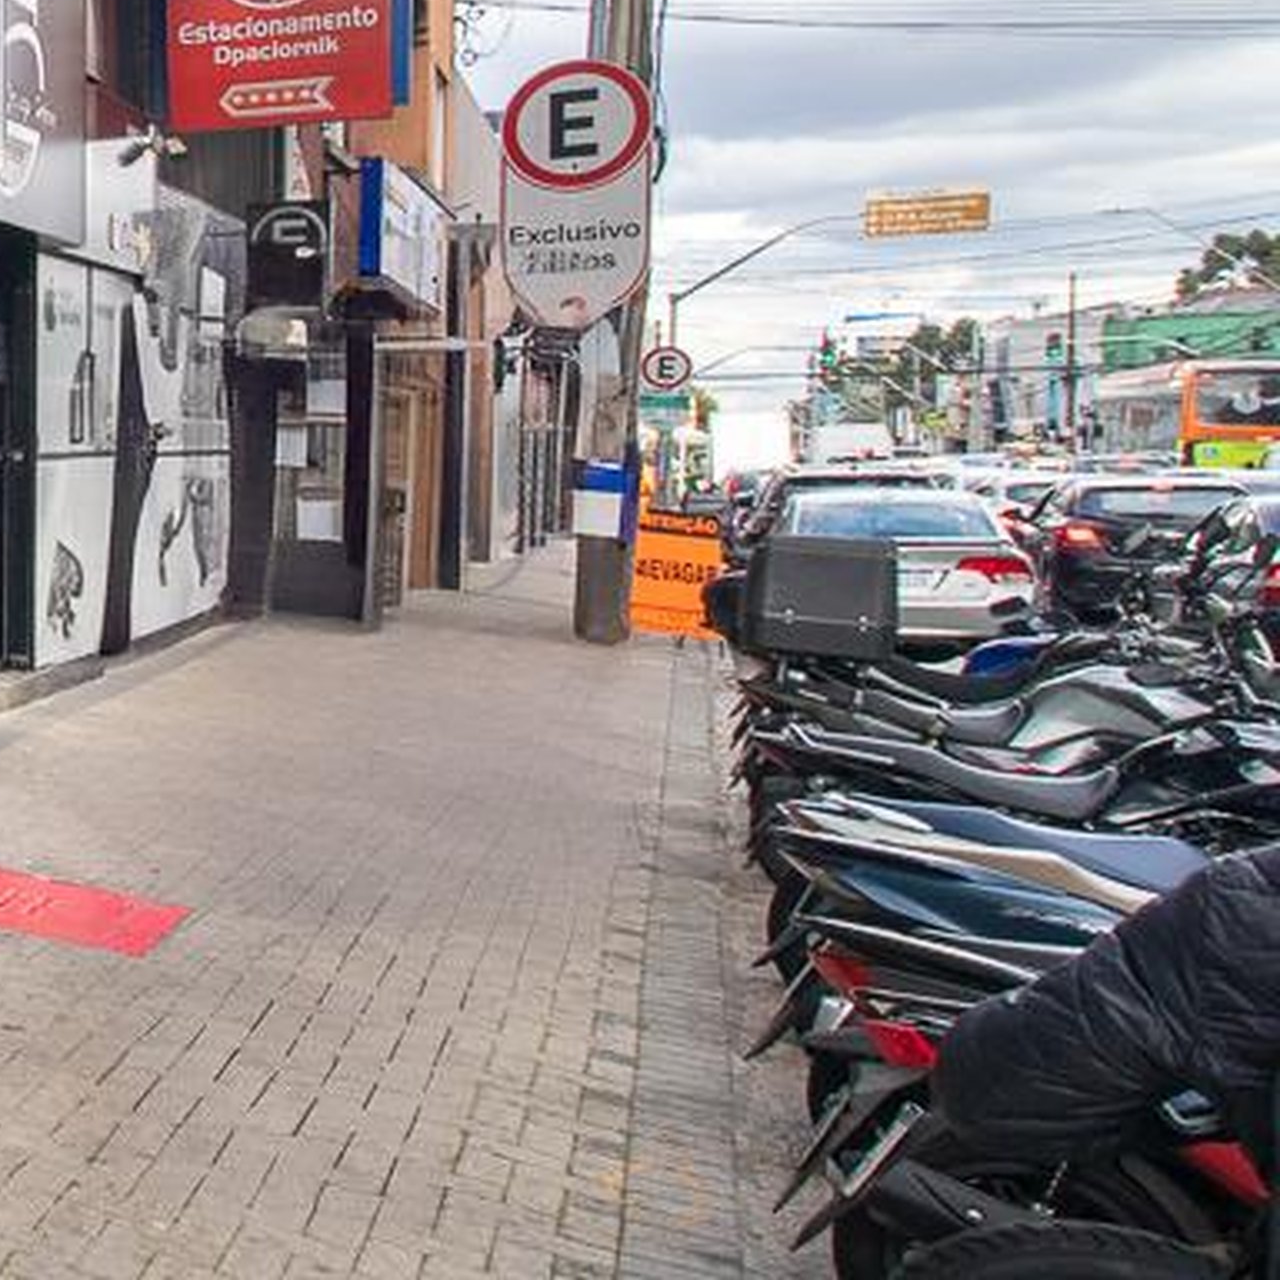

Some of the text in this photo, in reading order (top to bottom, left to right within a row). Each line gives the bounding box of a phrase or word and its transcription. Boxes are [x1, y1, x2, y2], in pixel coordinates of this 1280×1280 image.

[178, 5, 379, 45] Estacionamento
[549, 87, 600, 160] E
[509, 218, 642, 246] Exclusivo
[656, 356, 678, 380] E
